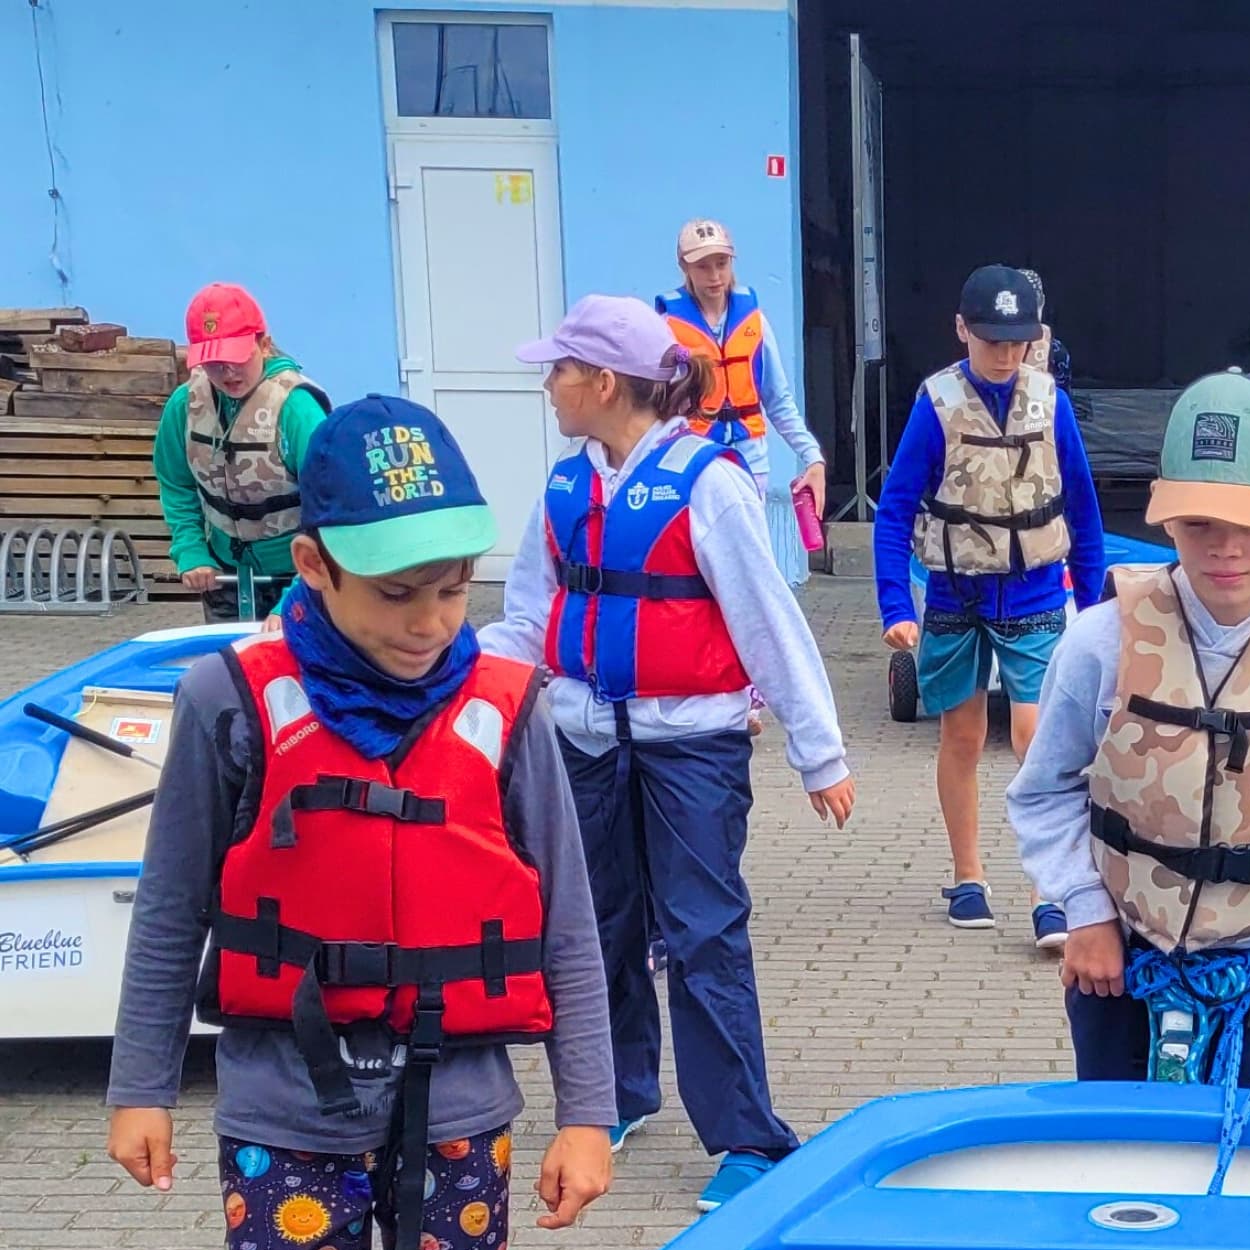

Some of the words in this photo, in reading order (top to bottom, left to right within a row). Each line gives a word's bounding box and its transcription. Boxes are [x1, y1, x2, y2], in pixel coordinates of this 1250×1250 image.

[363, 425, 425, 450] KIDS
[365, 441, 435, 474] RUN
[372, 480, 444, 507] WORLD
[274, 721, 320, 756] TRIBORD
[1, 949, 83, 972] FRIEND
